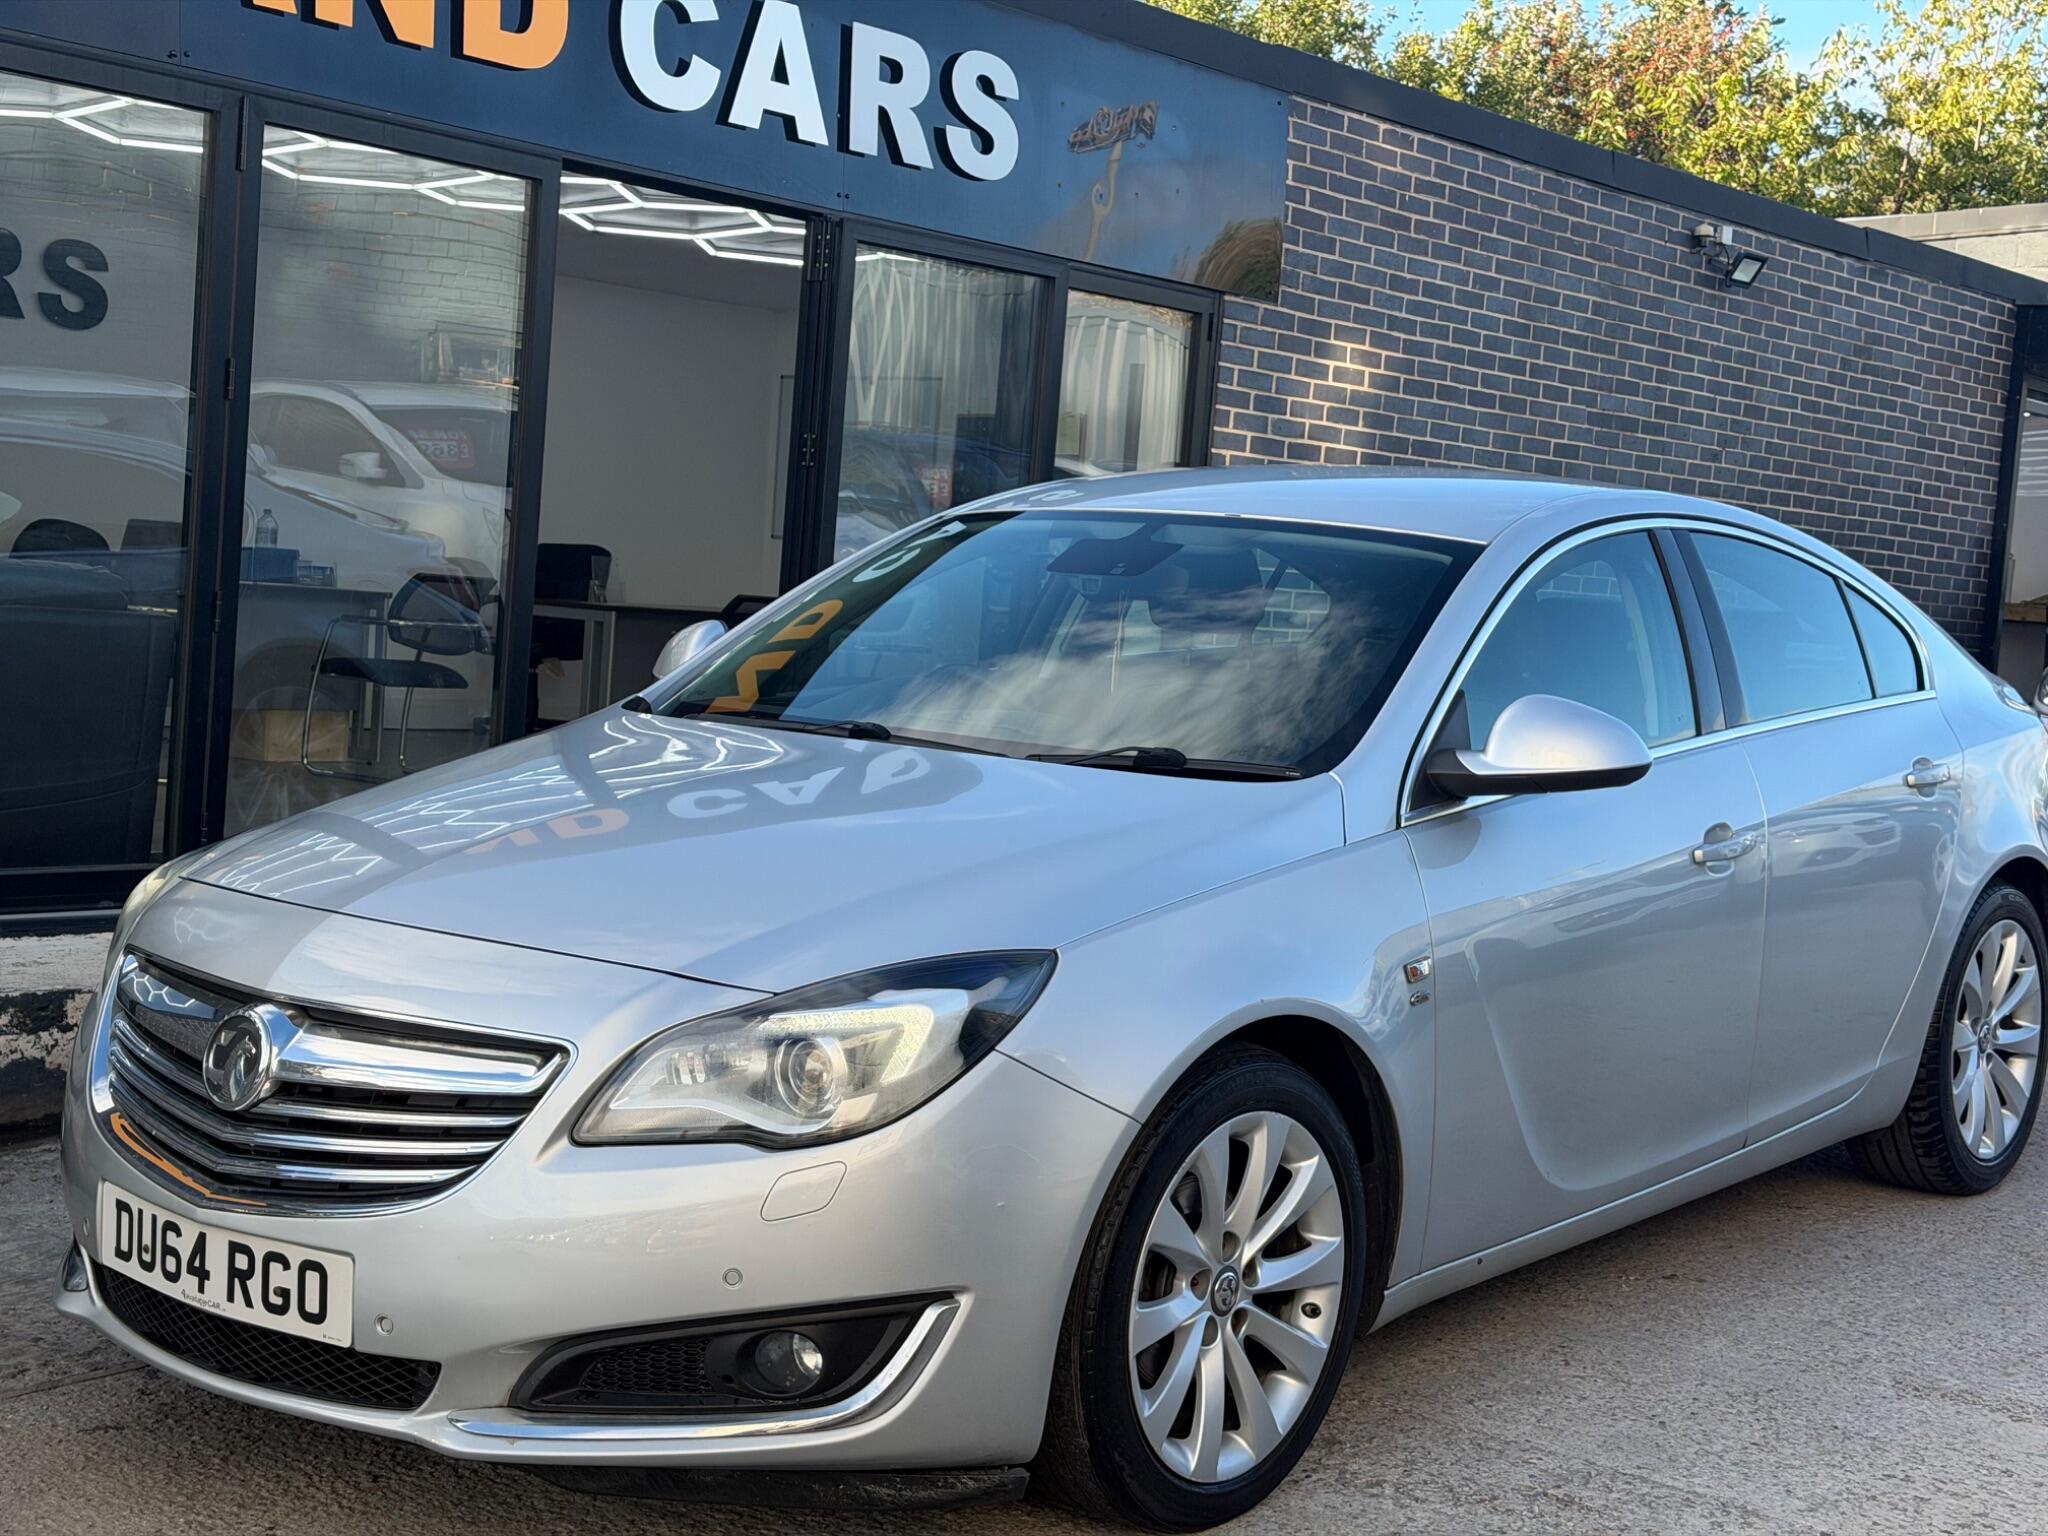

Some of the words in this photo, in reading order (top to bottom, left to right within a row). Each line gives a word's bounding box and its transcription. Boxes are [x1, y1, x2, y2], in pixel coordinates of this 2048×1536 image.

[613, 0, 1020, 181] CARS
[115, 1198, 210, 1294] DU64
[226, 1240, 328, 1325] RGO
